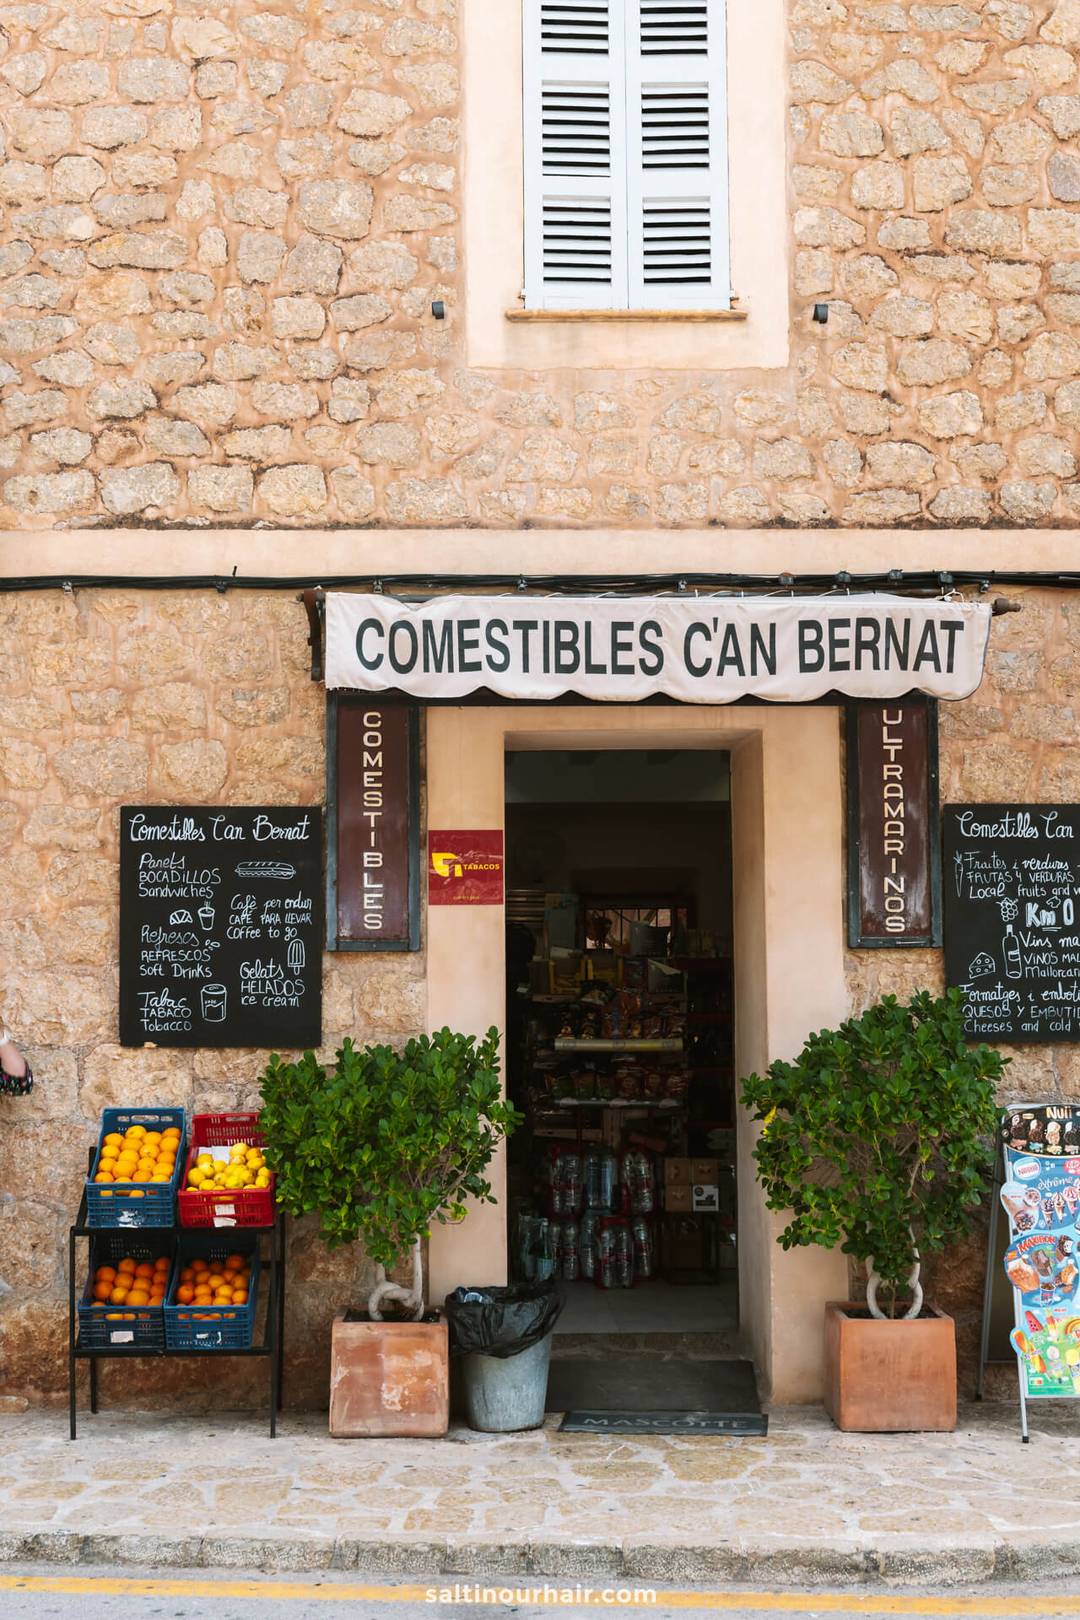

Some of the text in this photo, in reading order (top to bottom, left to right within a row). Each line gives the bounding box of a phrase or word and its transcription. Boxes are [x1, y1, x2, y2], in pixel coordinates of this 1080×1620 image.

[355, 616, 965, 677] COMESTIBLES C'AN BERNAT
[128, 813, 311, 842] Comestibles Can Bernat
[362, 711, 384, 930] COMESTIBLES
[882, 709, 905, 933] ULTRAMARINOS
[954, 811, 1075, 838] Comestibles Can
[966, 870, 1013, 884] FRUTAS
[1029, 870, 1074, 883] VERDURAS
[138, 882, 214, 898] Sandwiches
[969, 882, 1006, 899] Local
[1052, 883, 1070, 896] and
[268, 926, 280, 938] to
[1019, 930, 1052, 947] Vins
[141, 949, 211, 963] REFRESCOS
[140, 963, 165, 976] Soft
[241, 978, 305, 996] HELADOS
[262, 995, 300, 1007] cream
[139, 1007, 192, 1018] TABACO
[139, 1018, 192, 1031] Tobacco
[963, 1018, 1071, 1033] Cheeses and cold
[583, 1417, 747, 1429] MASCOTTE
